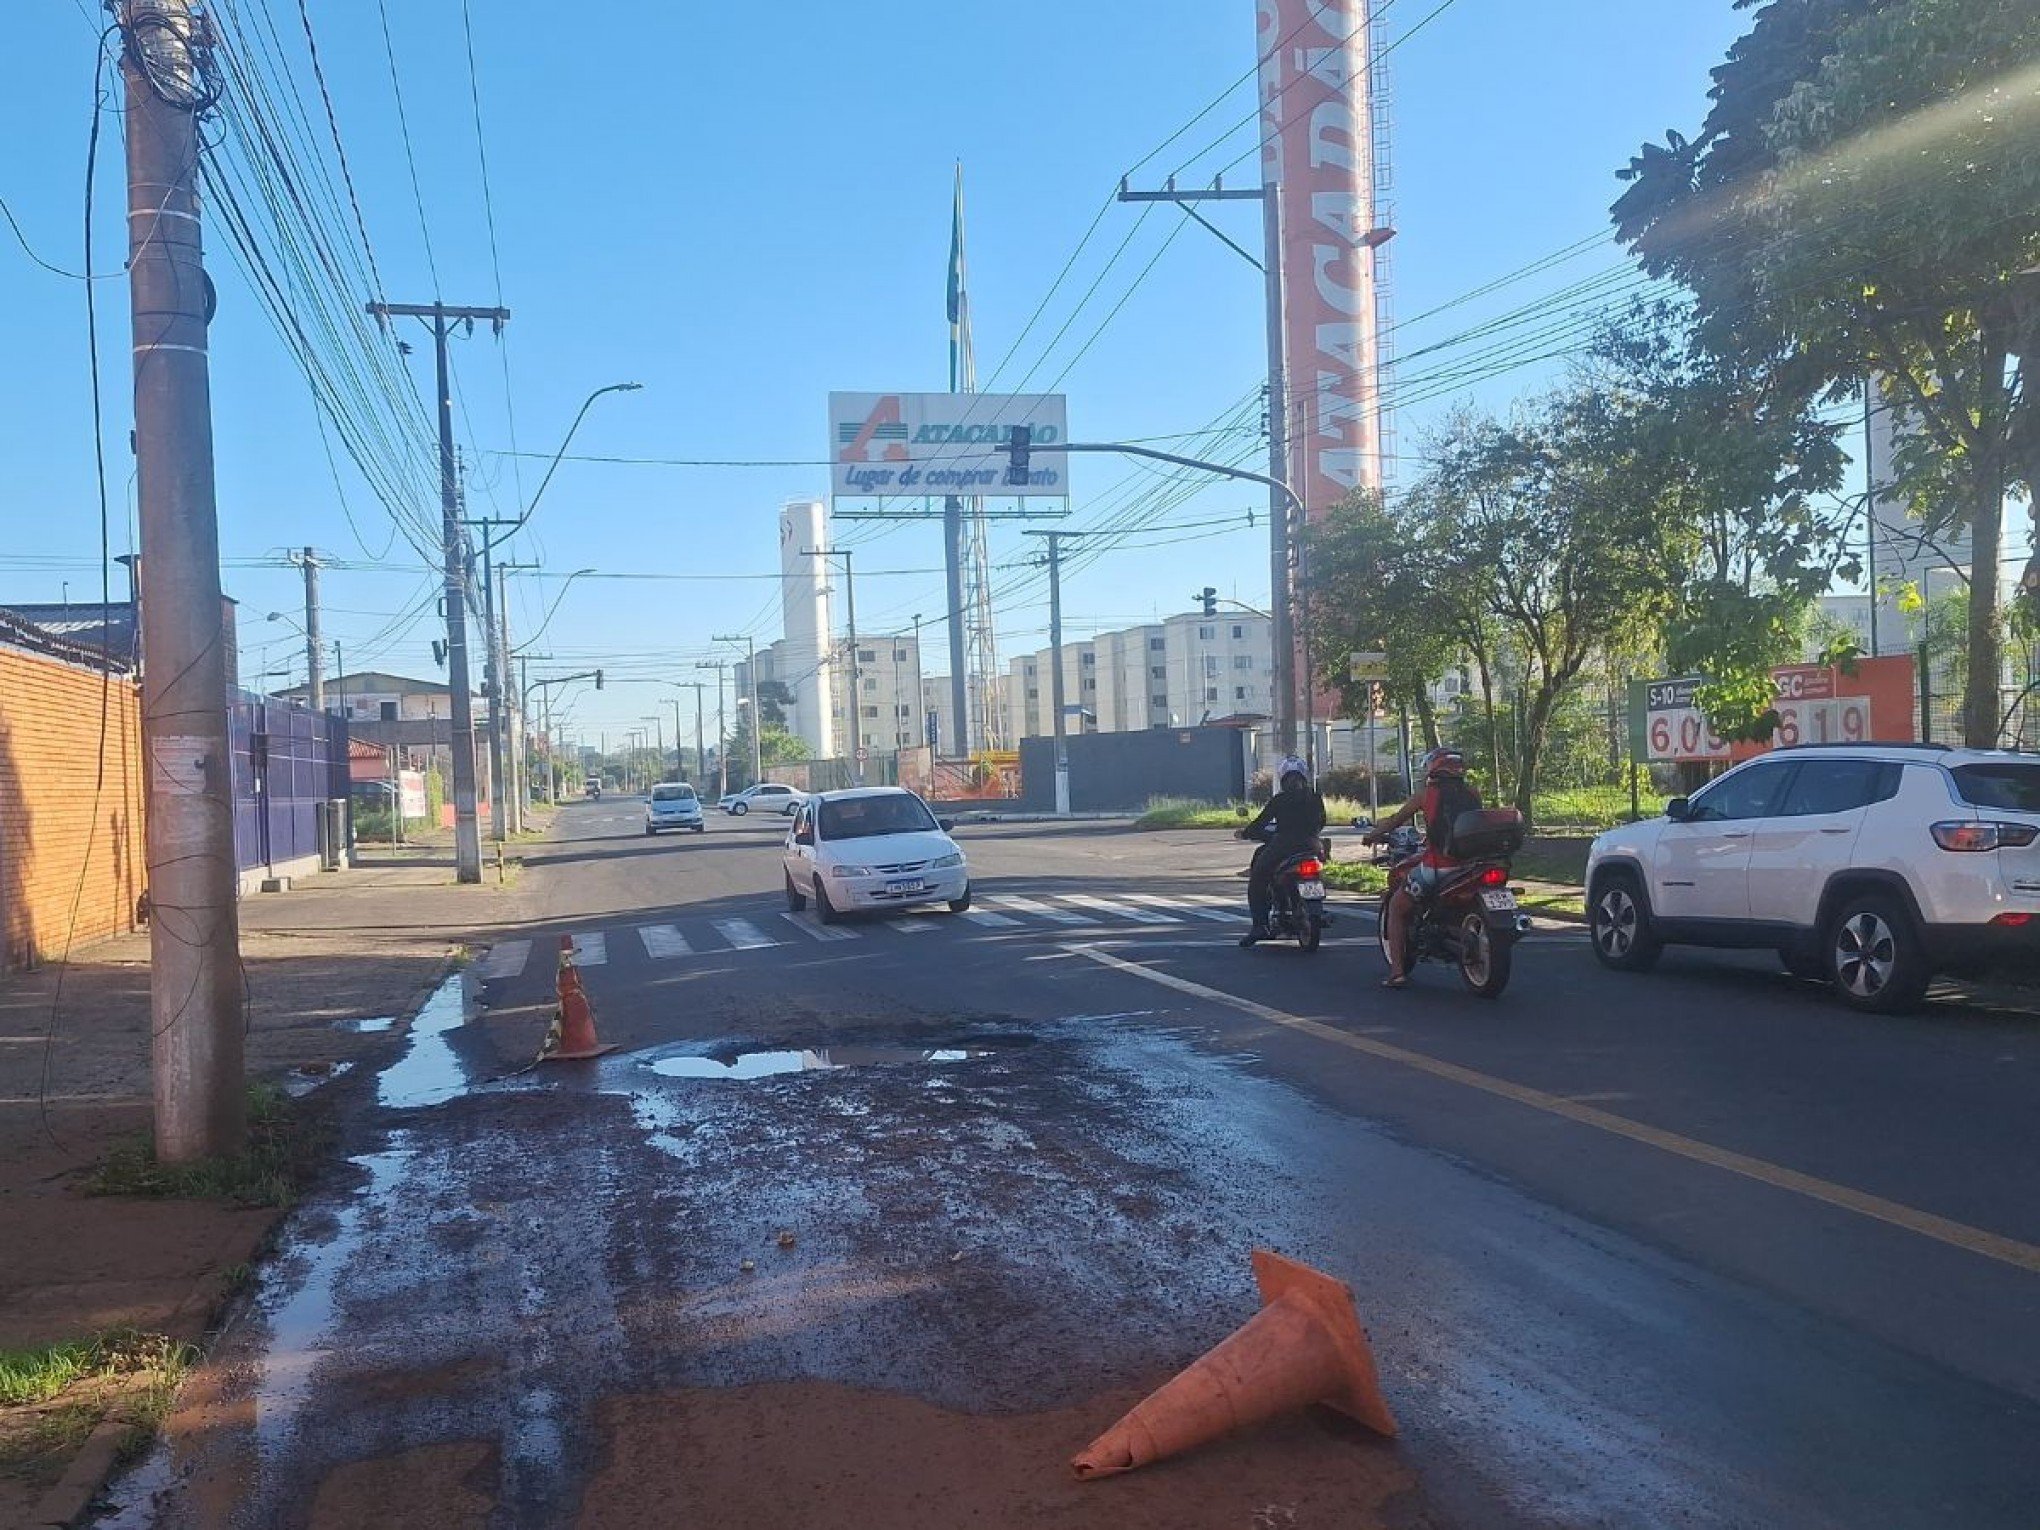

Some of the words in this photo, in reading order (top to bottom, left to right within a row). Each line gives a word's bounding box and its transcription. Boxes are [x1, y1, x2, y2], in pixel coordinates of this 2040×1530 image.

[845, 465, 895, 492] Lugar
[899, 464, 921, 486] de
[926, 470, 998, 488] comprar
[1650, 686, 1674, 706] S-10
